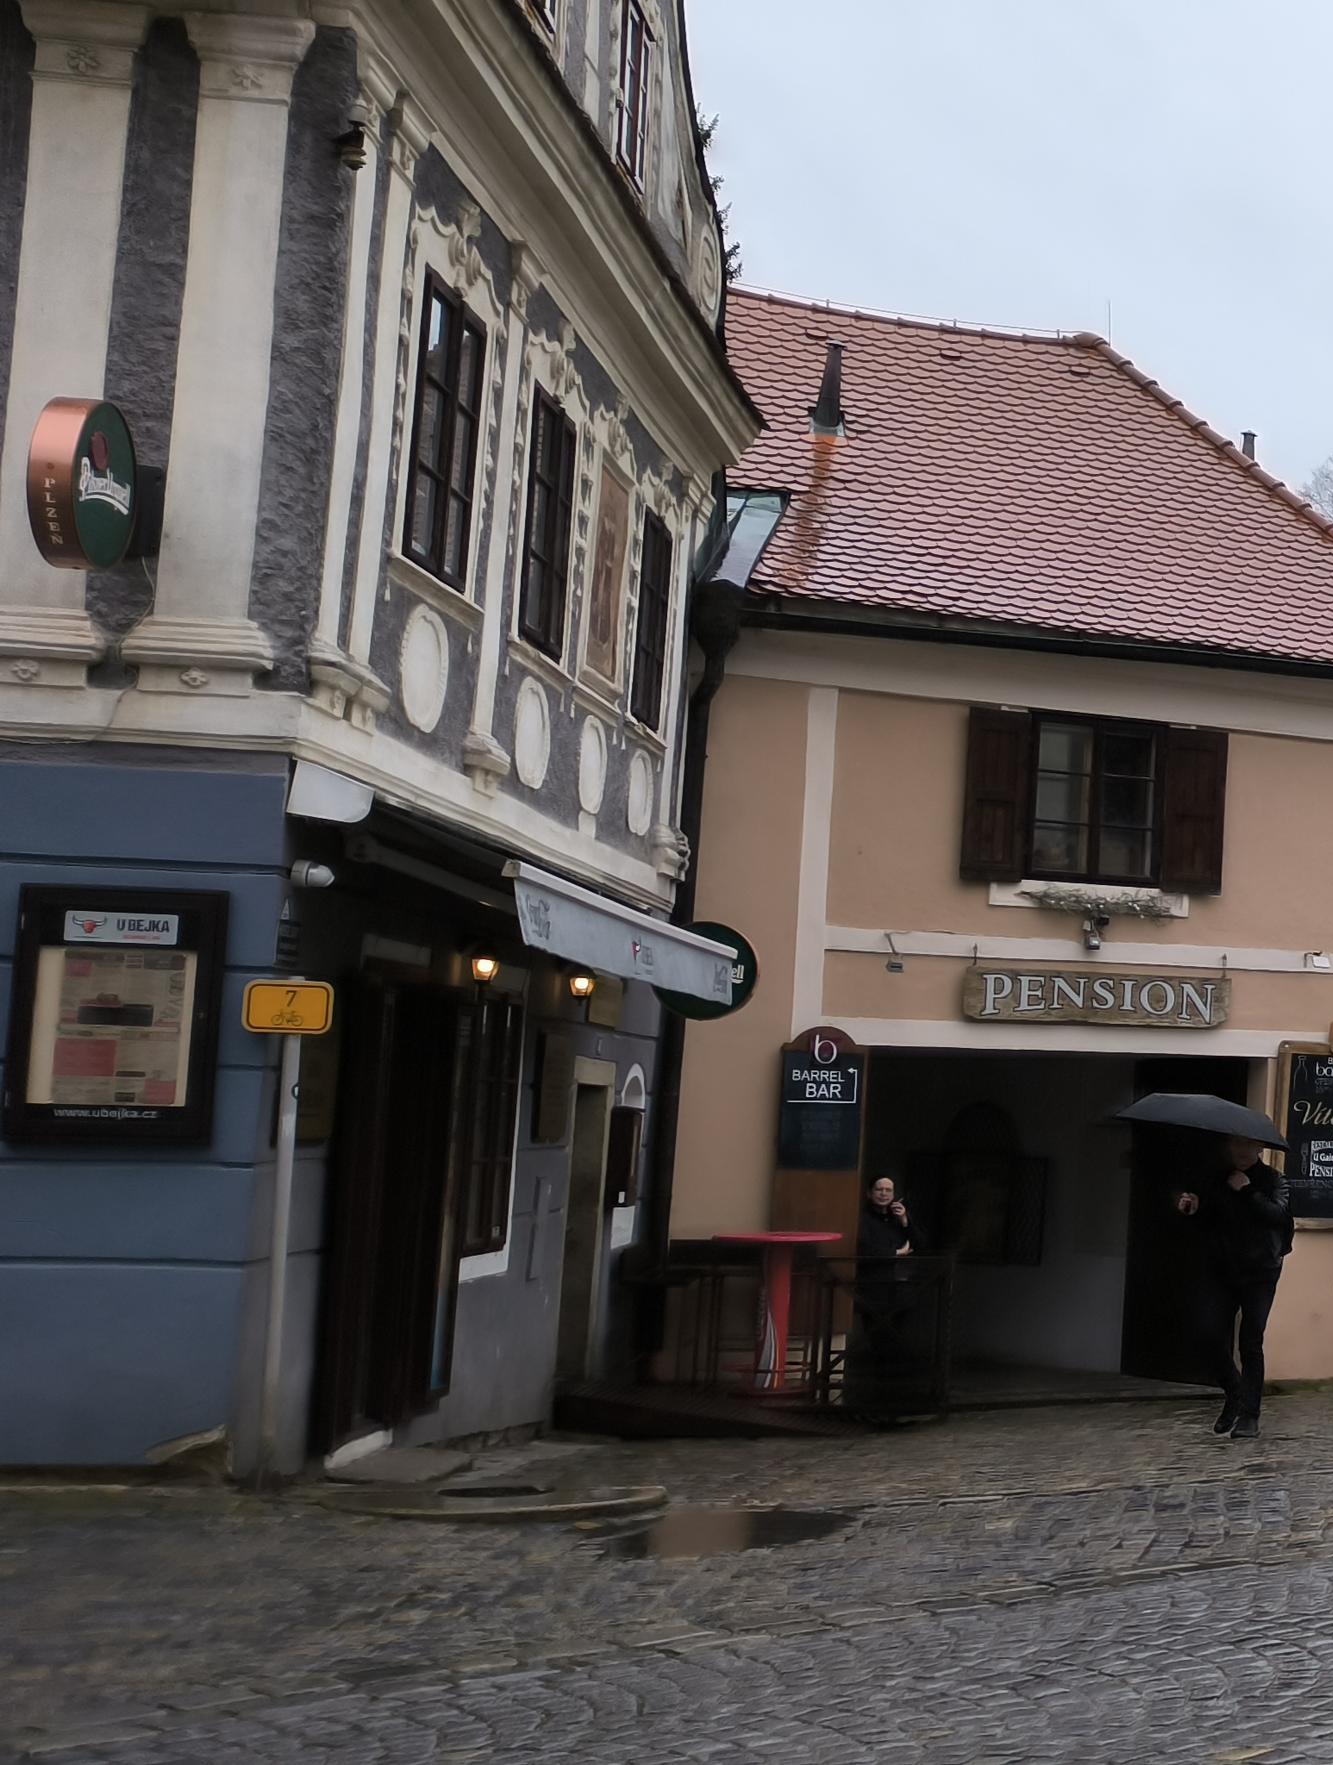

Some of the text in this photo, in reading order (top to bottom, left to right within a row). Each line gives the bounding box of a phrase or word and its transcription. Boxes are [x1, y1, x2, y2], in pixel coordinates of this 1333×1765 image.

[116, 918, 170, 933] U BEJKA
[285, 990, 298, 1007] 7
[979, 973, 1216, 1024] PENSION
[792, 1069, 845, 1082] BARREL
[805, 1083, 842, 1098] BAR
